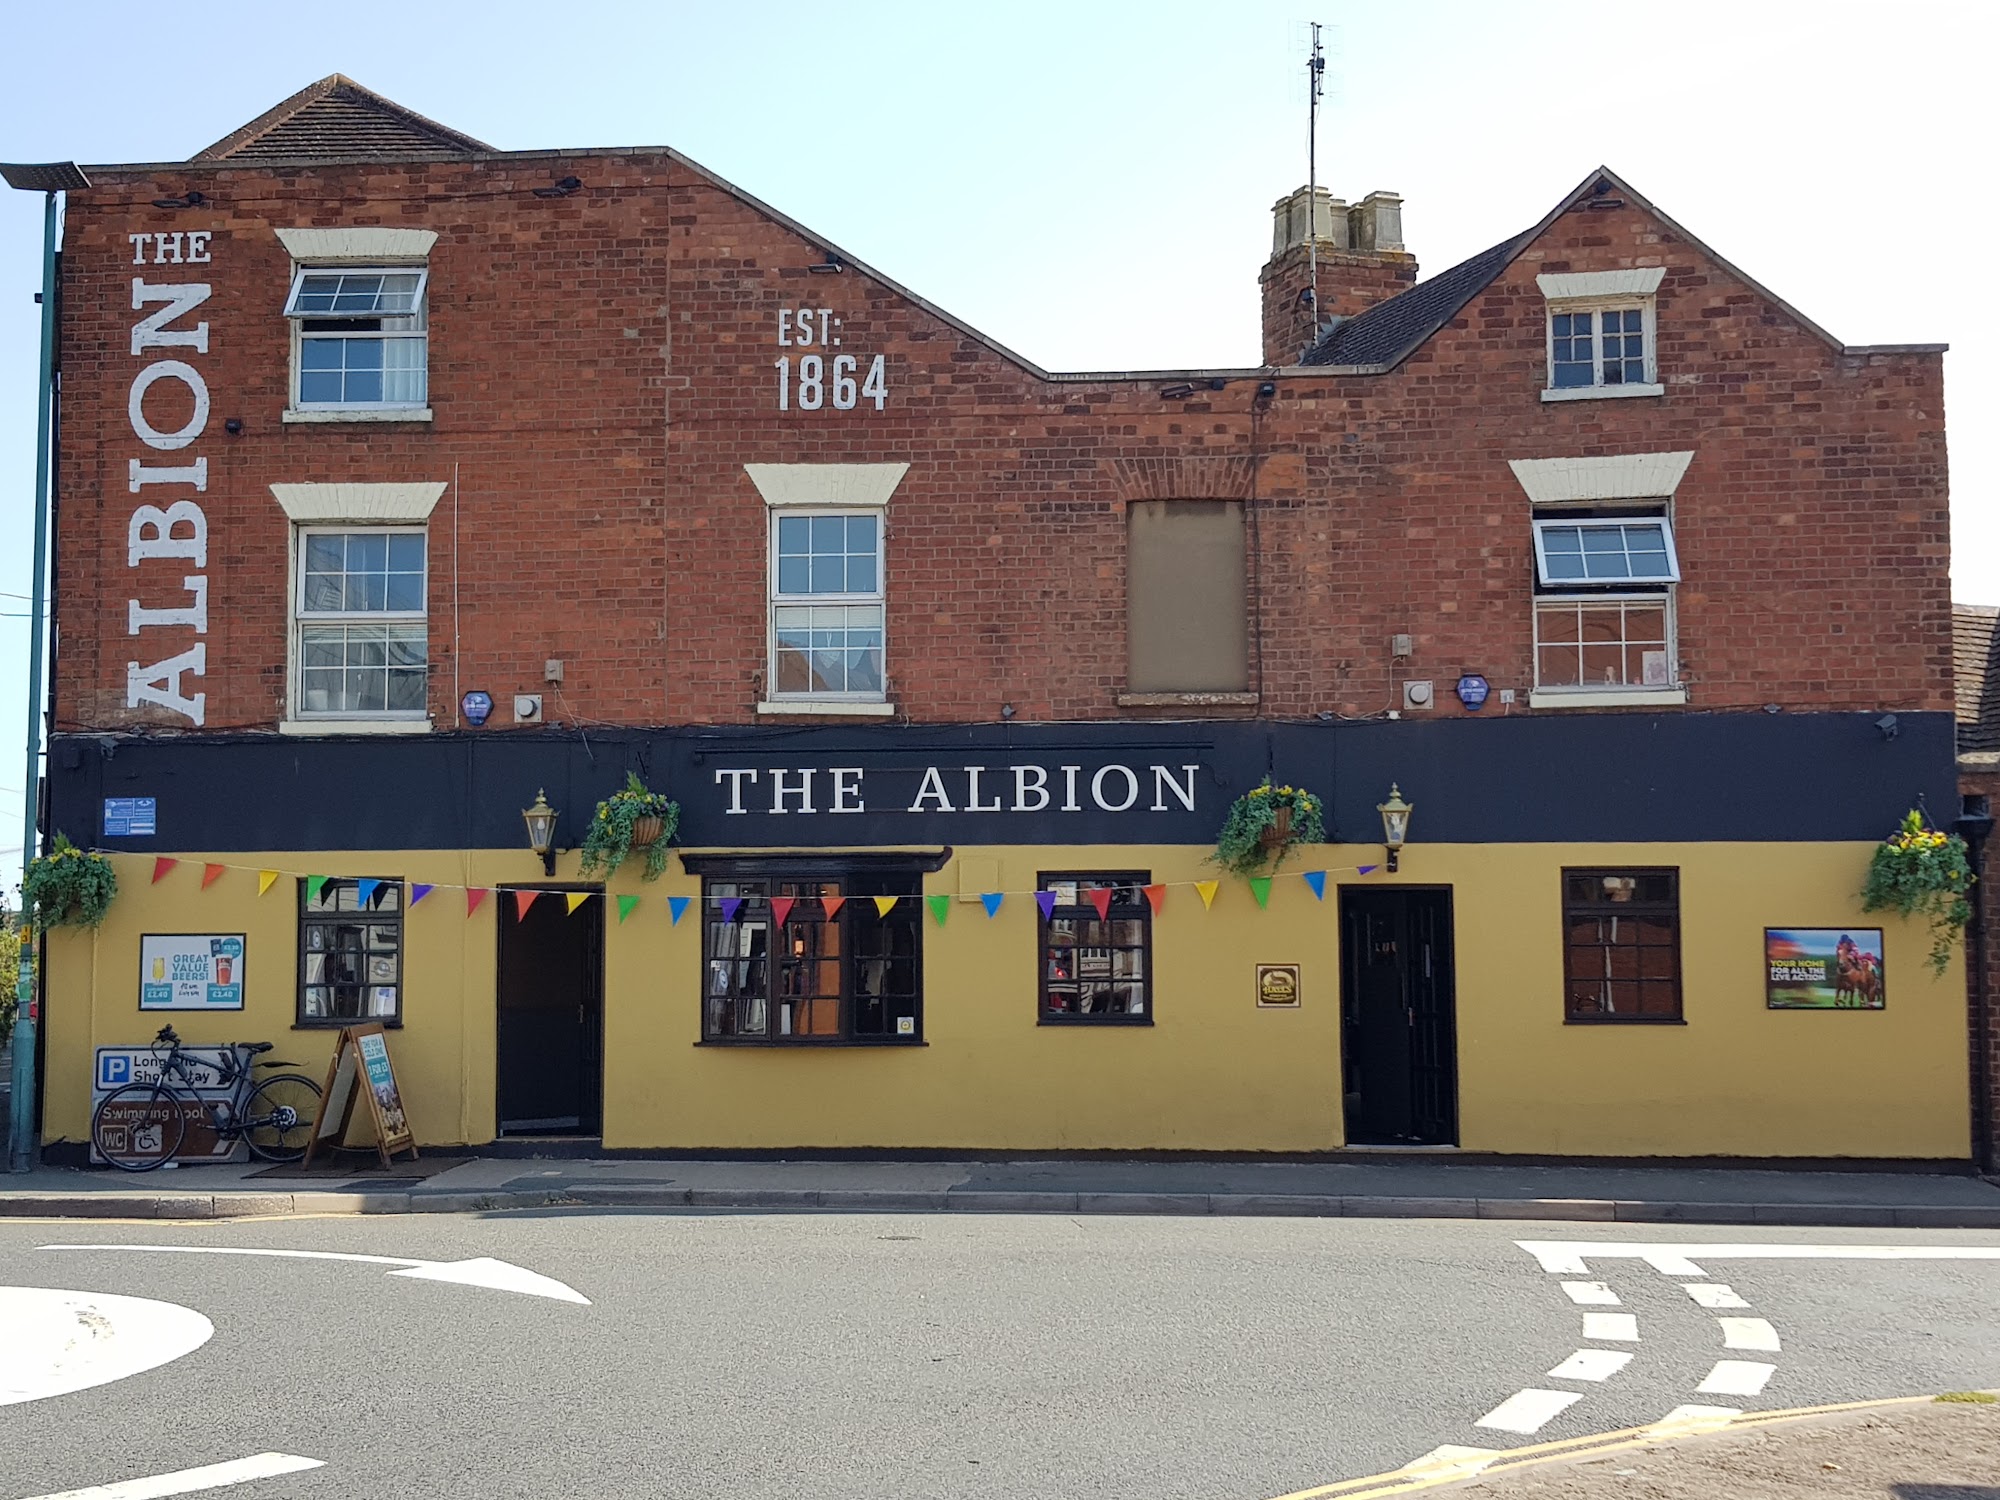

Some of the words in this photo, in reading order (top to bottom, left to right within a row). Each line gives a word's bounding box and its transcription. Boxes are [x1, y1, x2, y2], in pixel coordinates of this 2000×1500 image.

[129, 231, 212, 265] THE
[778, 308, 841, 347] EST:
[774, 354, 889, 411] 1864
[127, 276, 212, 727] ALBION
[714, 767, 865, 815] THE
[907, 764, 1200, 813] ALBION
[172, 963, 209, 972] VALUE
[173, 954, 209, 963] GREAT
[172, 972, 209, 981] BEERS!
[108, 1058, 126, 1081] P
[133, 1056, 168, 1069] Long
[133, 1070, 173, 1082] Shot
[104, 1132, 124, 1148] WC
